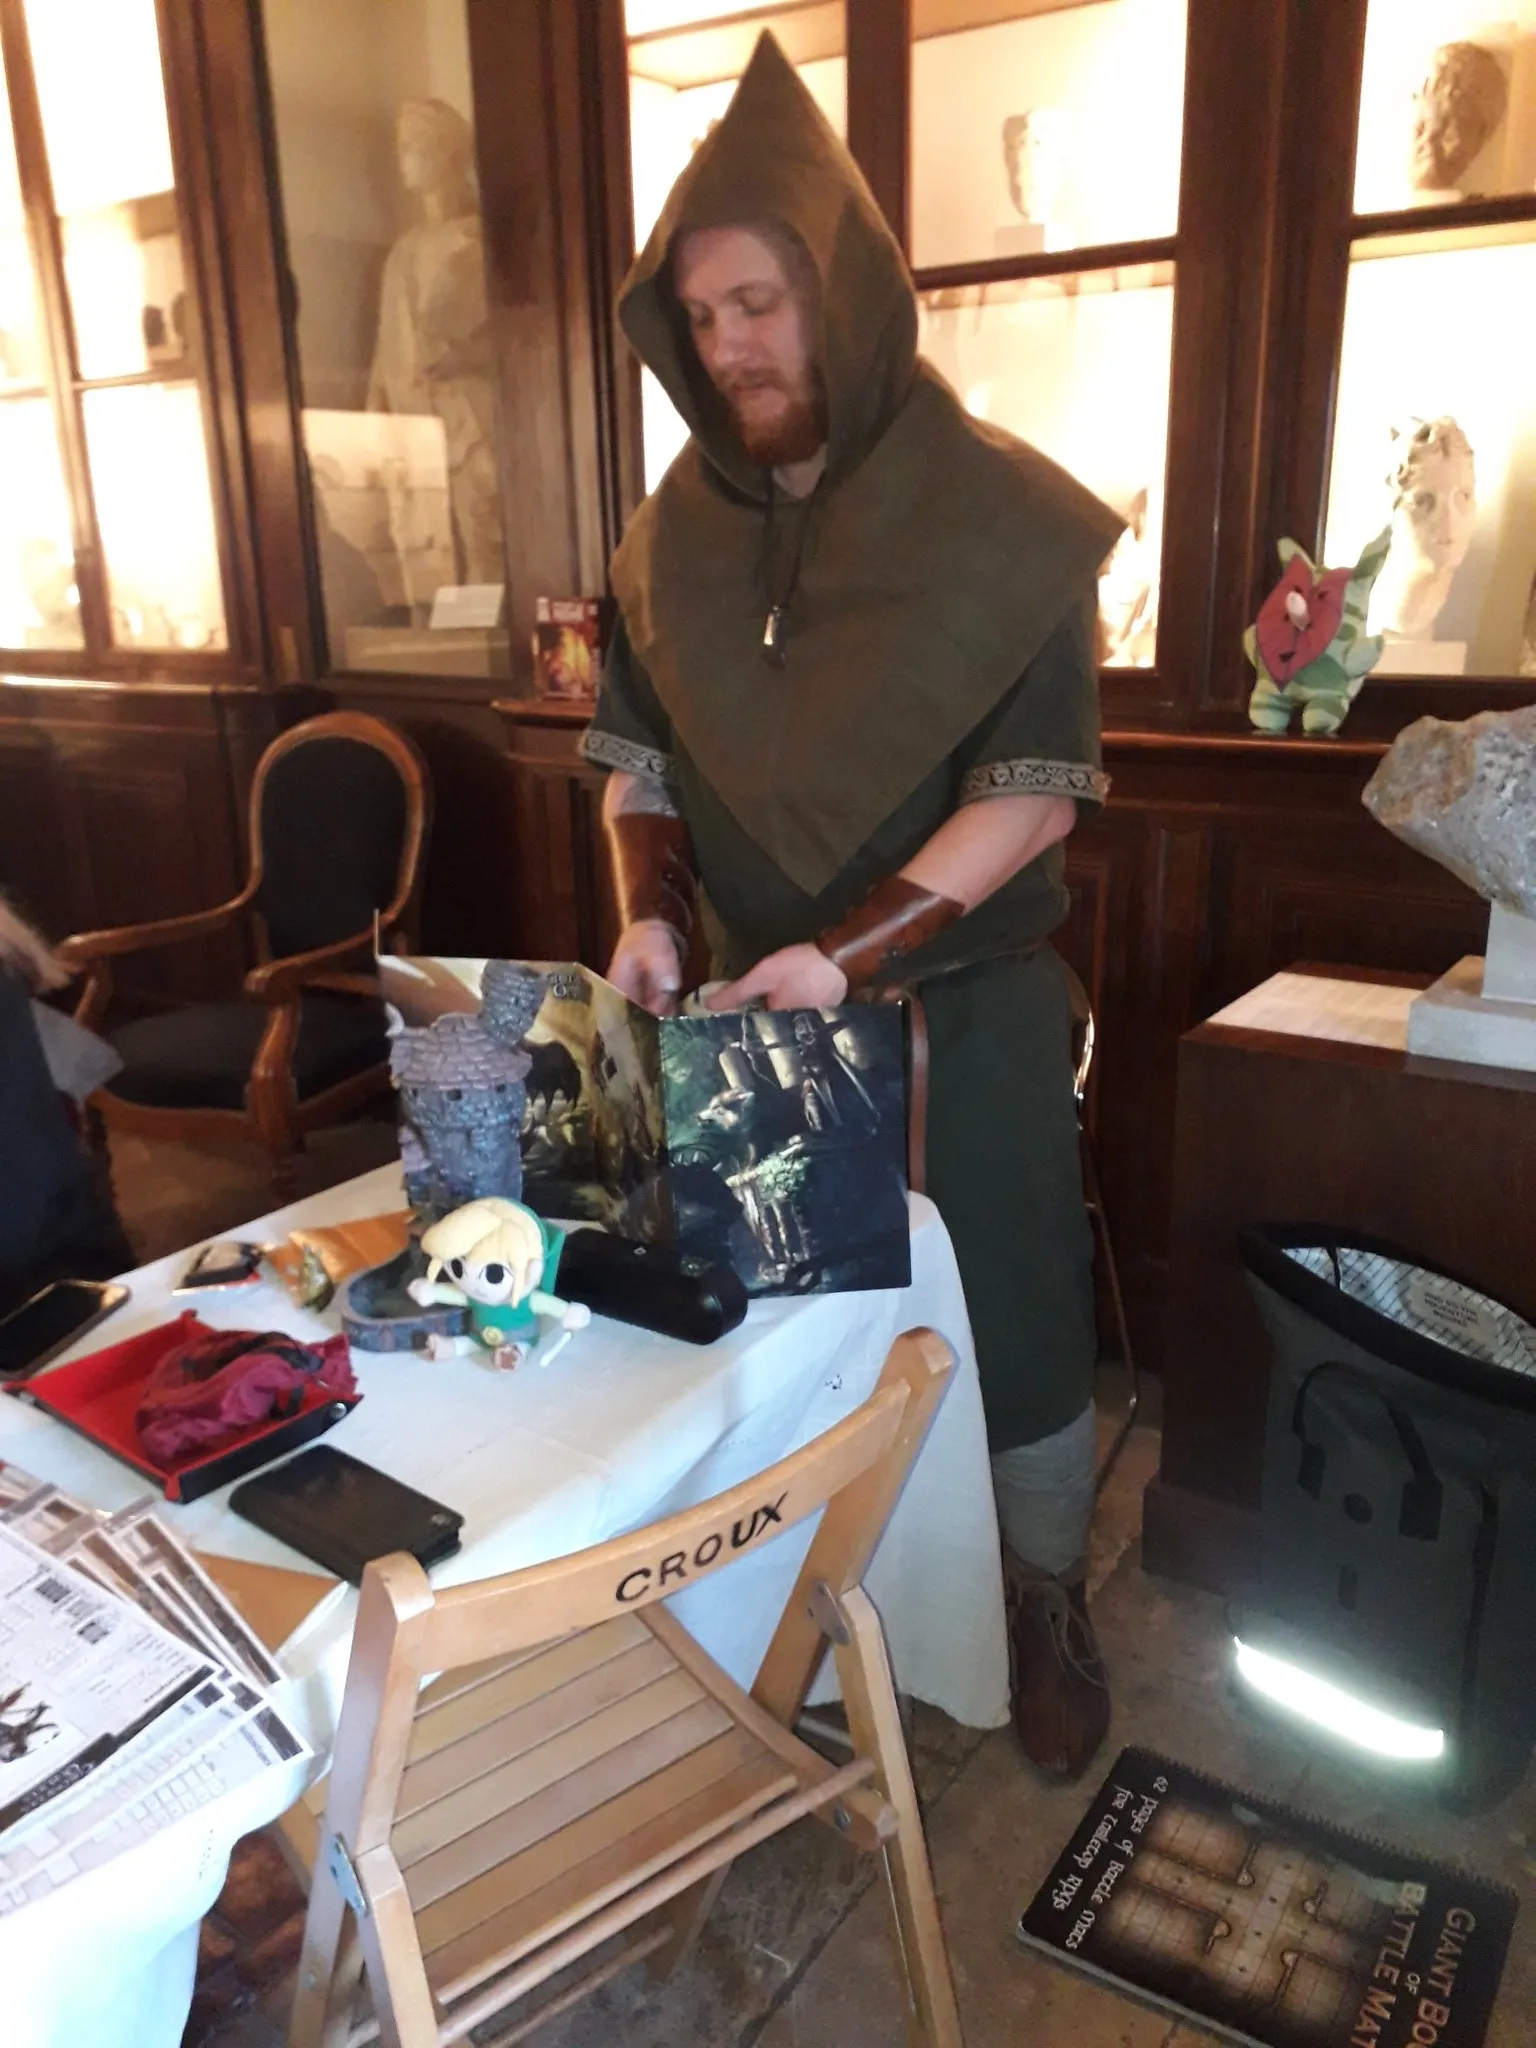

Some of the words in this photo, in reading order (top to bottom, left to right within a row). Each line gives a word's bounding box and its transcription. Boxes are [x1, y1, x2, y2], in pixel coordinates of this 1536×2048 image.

[615, 1490, 789, 1603] CROUX
[1112, 1784, 1135, 1810] for
[1153, 1776, 1169, 1793] 62
[1130, 1794, 1159, 1834] pages
[1073, 1814, 1119, 1869] Tabletop
[1113, 1839, 1134, 1858] of
[1091, 1860, 1126, 1904] Battle
[1065, 1909, 1096, 1950] Mats
[1372, 1880, 1428, 1985] BATTLE
[1427, 1907, 1477, 1998] GIANT
[1404, 1972, 1421, 1997] OF
[1405, 1997, 1451, 2048] BO
